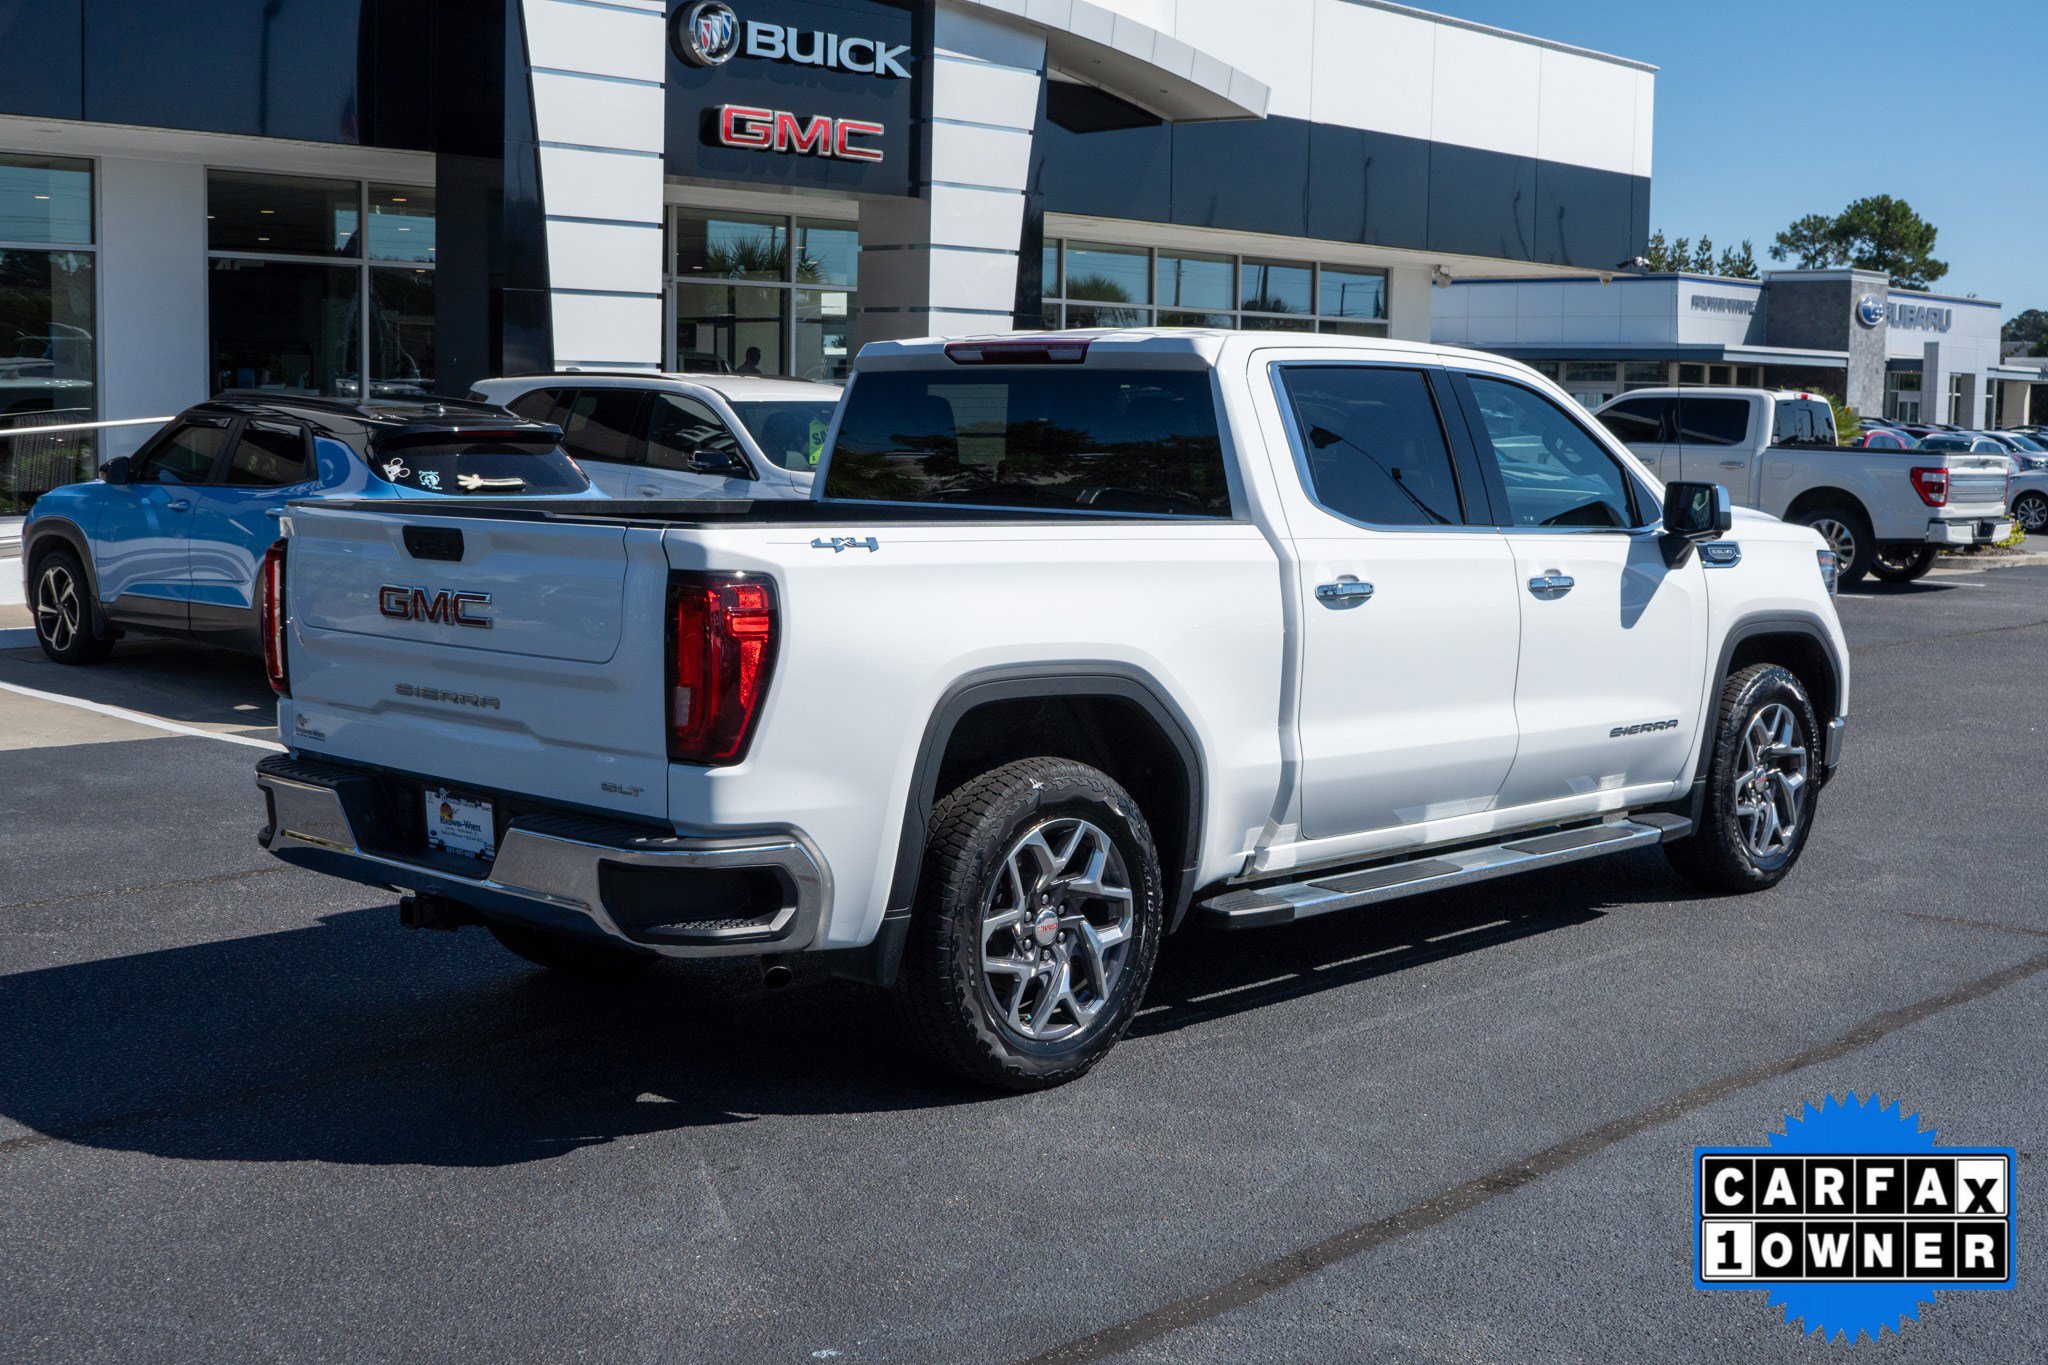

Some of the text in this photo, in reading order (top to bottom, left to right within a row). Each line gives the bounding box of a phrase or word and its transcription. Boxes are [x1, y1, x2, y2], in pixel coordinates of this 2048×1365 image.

[746, 20, 912, 79] BUICK
[720, 104, 884, 163] GMC
[379, 583, 493, 629] GMC
[395, 683, 500, 709] SIERRA
[1609, 719, 1679, 738] SIERRA
[601, 782, 644, 796] SLT
